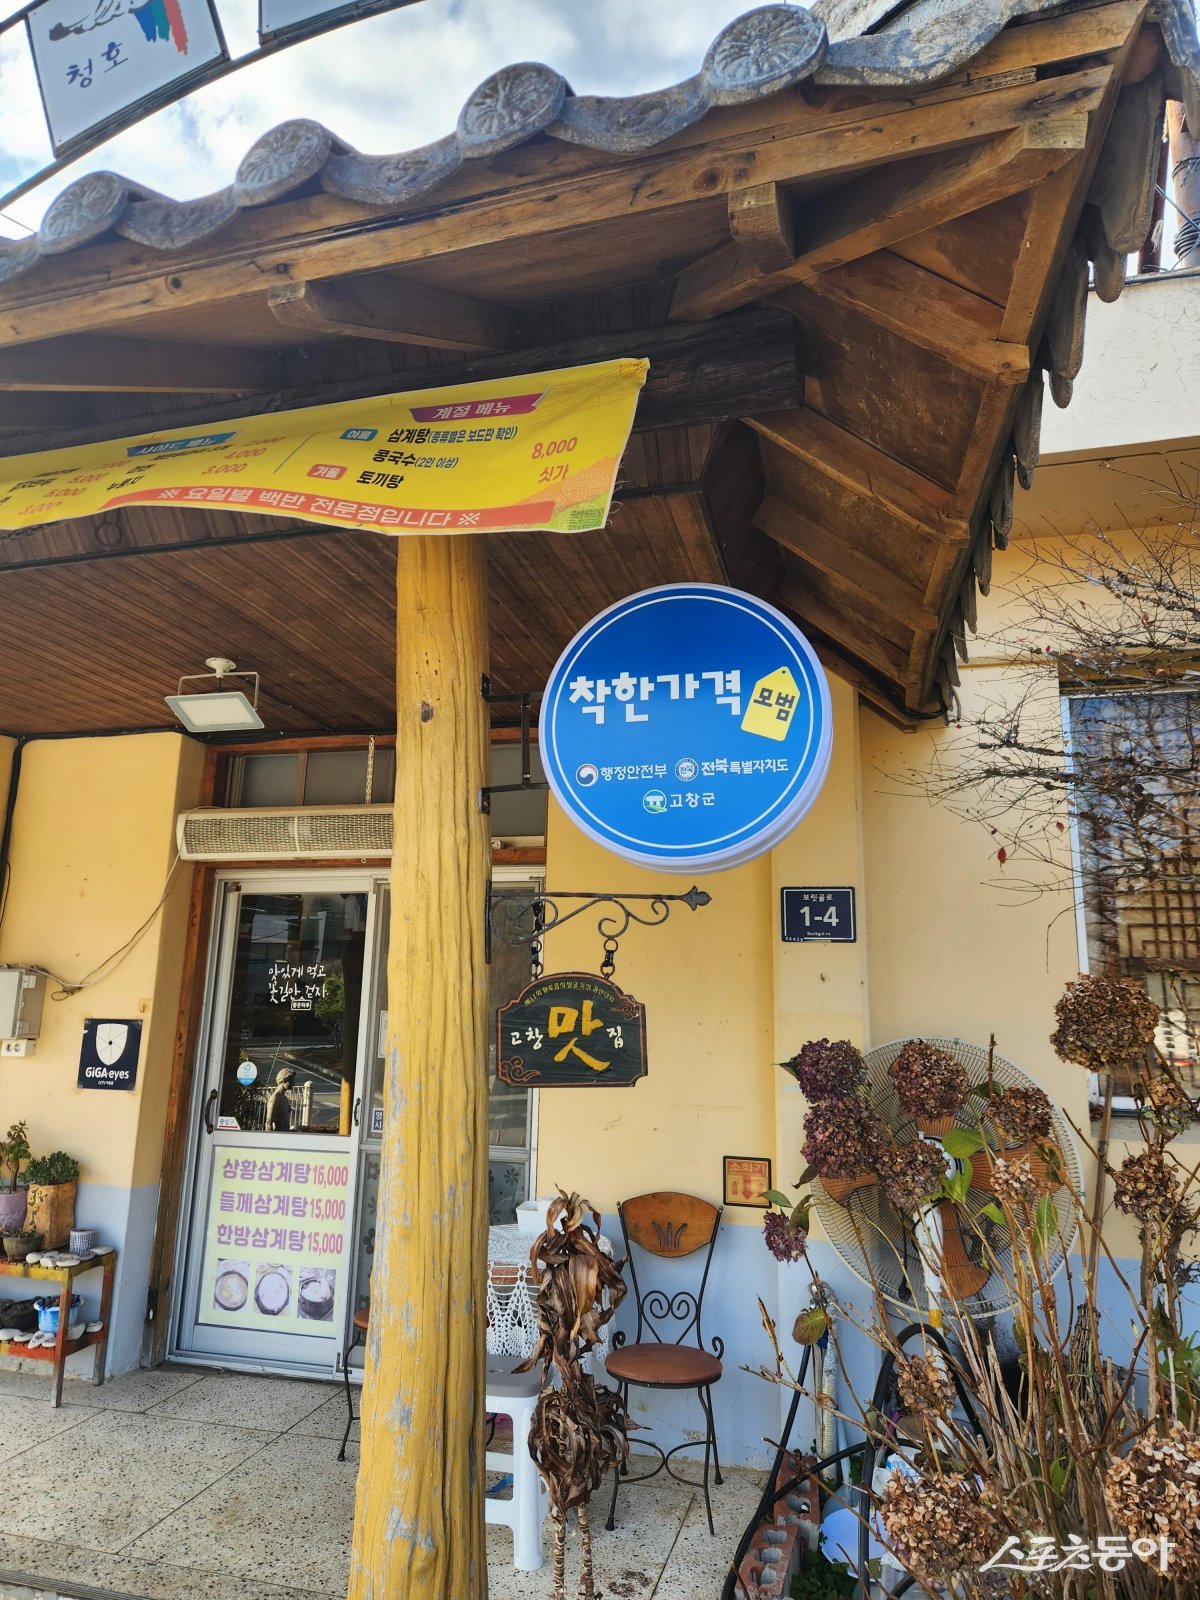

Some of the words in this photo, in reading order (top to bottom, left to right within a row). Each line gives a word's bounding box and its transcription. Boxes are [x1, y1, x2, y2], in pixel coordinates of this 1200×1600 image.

[66, 42, 128, 88] 청호
[432, 405, 471, 420] 계절
[475, 401, 512, 416] 메뉴
[347, 430, 369, 440] 여름
[496, 426, 518, 440] 확인)
[134, 442, 184, 456] 사이드
[223, 447, 267, 459] 4,000
[532, 436, 578, 459] 8,000
[201, 463, 248, 475] 3,000
[312, 465, 341, 479] 겨울
[435, 457, 459, 469] 이상)
[356, 470, 405, 489] 토끼탕
[538, 463, 570, 483] 싯가
[183, 486, 253, 503] 요일별
[259, 490, 306, 509] 백반
[308, 496, 452, 527] 전문점입니다
[568, 669, 742, 725] 착한가격
[753, 687, 796, 722] 모범
[600, 763, 668, 782] 행정안전부
[701, 757, 789, 776] 전북특별자치도
[669, 792, 716, 808] 고창군
[800, 906, 839, 927] 1-4
[306, 963, 326, 979] 먹고
[510, 1026, 544, 1050] 고창
[223, 1158, 311, 1185] 상황삼계탕
[313, 1164, 349, 1188] 16,000
[728, 1162, 766, 1177] 소화기
[219, 1190, 309, 1218] 들깨삼계탕
[309, 1197, 346, 1224] 15,000
[217, 1223, 306, 1252] 한방삼계탕
[307, 1231, 344, 1256] 15,000
